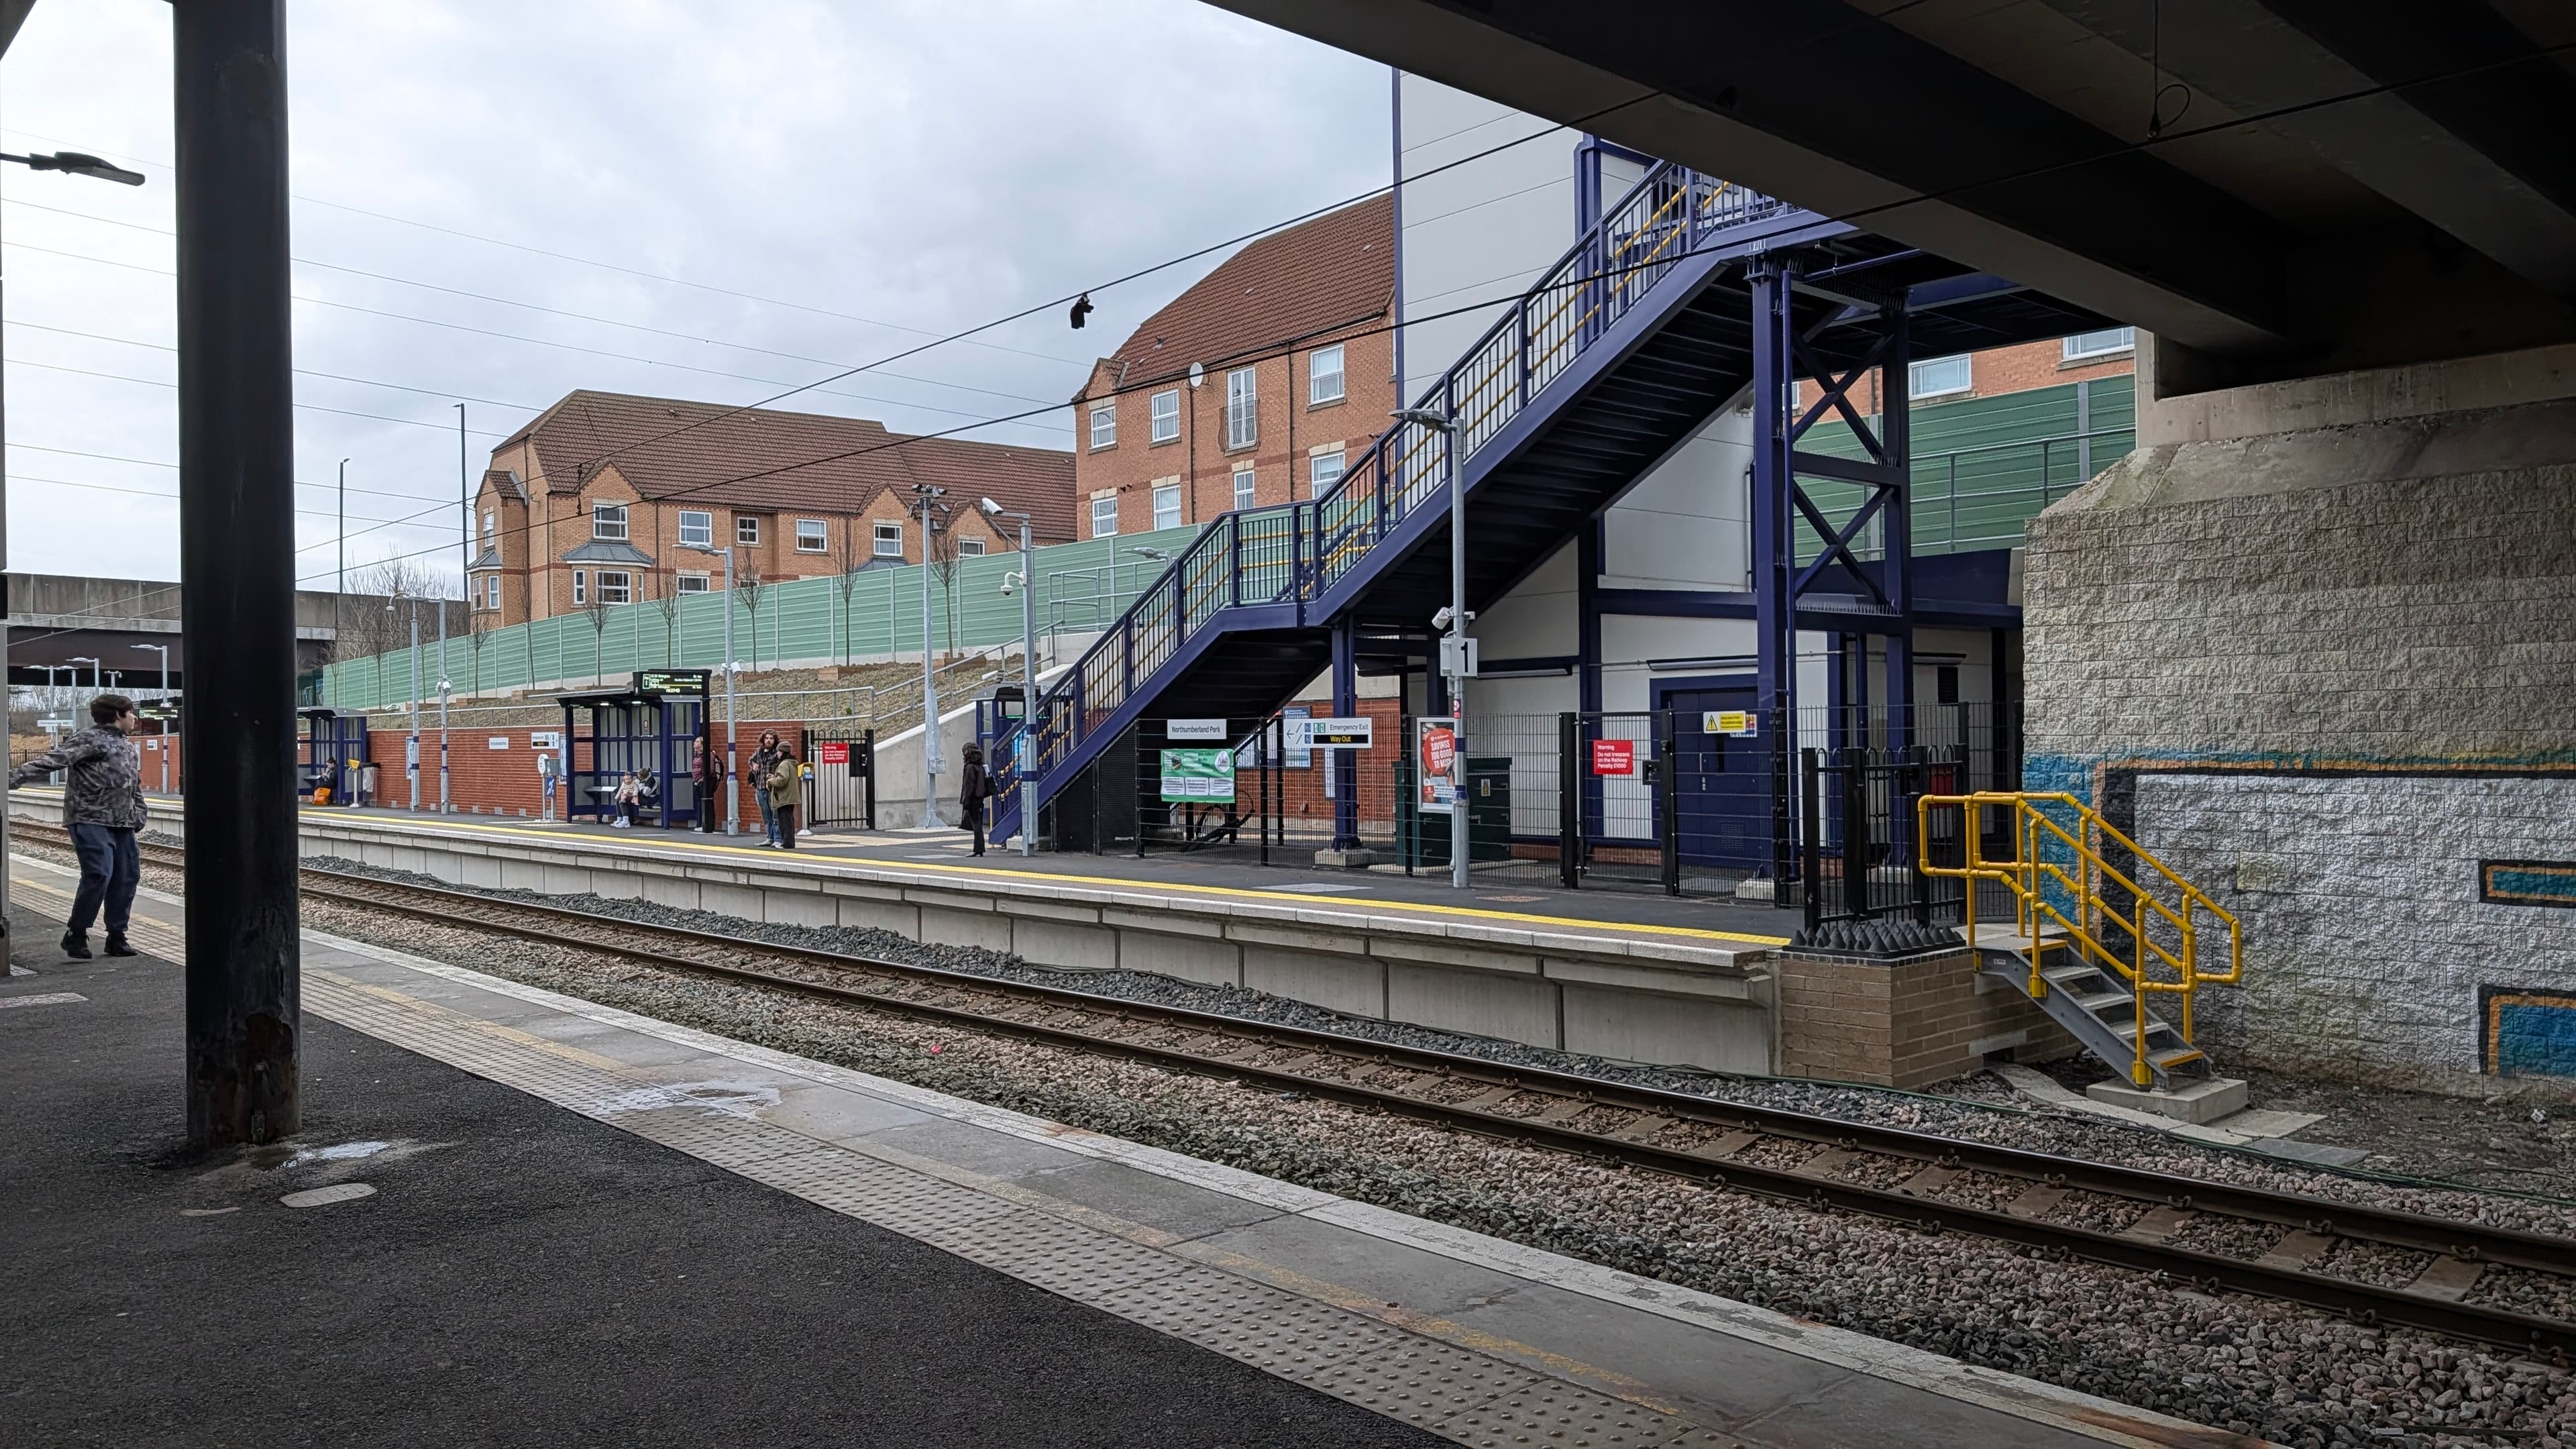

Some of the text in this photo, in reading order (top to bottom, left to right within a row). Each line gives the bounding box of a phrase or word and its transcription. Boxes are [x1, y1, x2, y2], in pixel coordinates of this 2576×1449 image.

[1461, 641, 1468, 674] 1
[1330, 724, 1358, 732] Emergency
[1431, 739, 1450, 751] SAVINGS
[1431, 749, 1452, 761] TOO GOOD
[1434, 759, 1440, 769] TO
